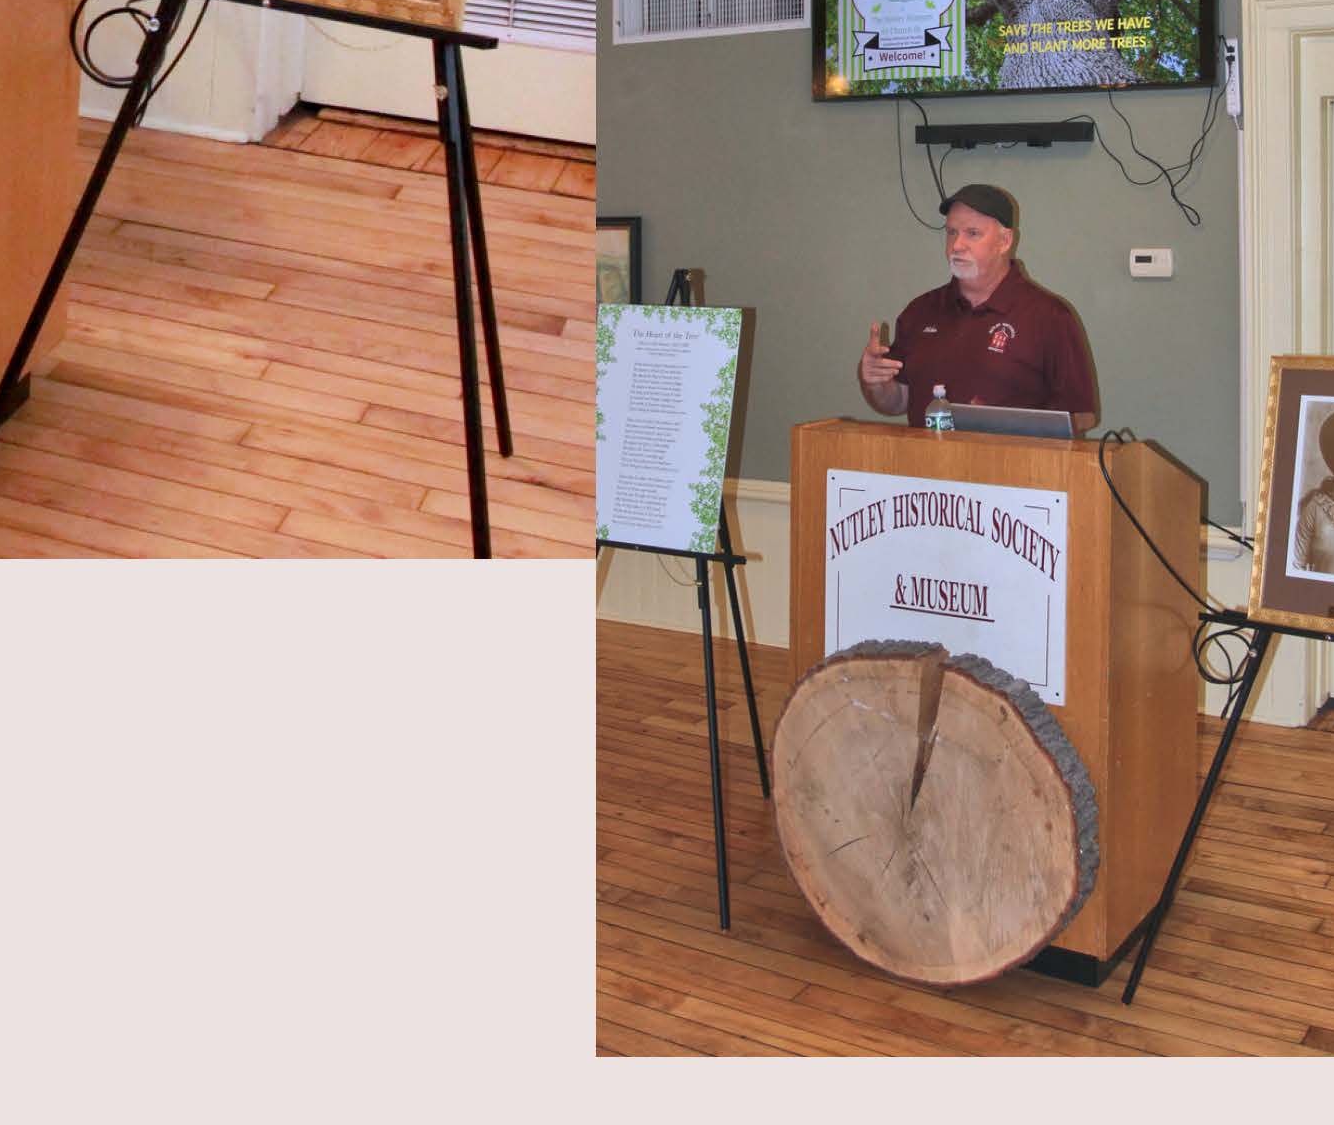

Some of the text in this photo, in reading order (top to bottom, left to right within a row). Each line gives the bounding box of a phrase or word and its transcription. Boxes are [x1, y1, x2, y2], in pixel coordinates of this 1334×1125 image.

[998, 16, 1151, 37] SAVE THE TREES WE HAVE
[1003, 35, 1147, 55] AND PLANT MORE TREES
[879, 50, 926, 62] Welcome!
[830, 491, 1060, 582] NUTLEY HISTORICAL SOCIETY
[895, 574, 988, 617] & MUSEUM
